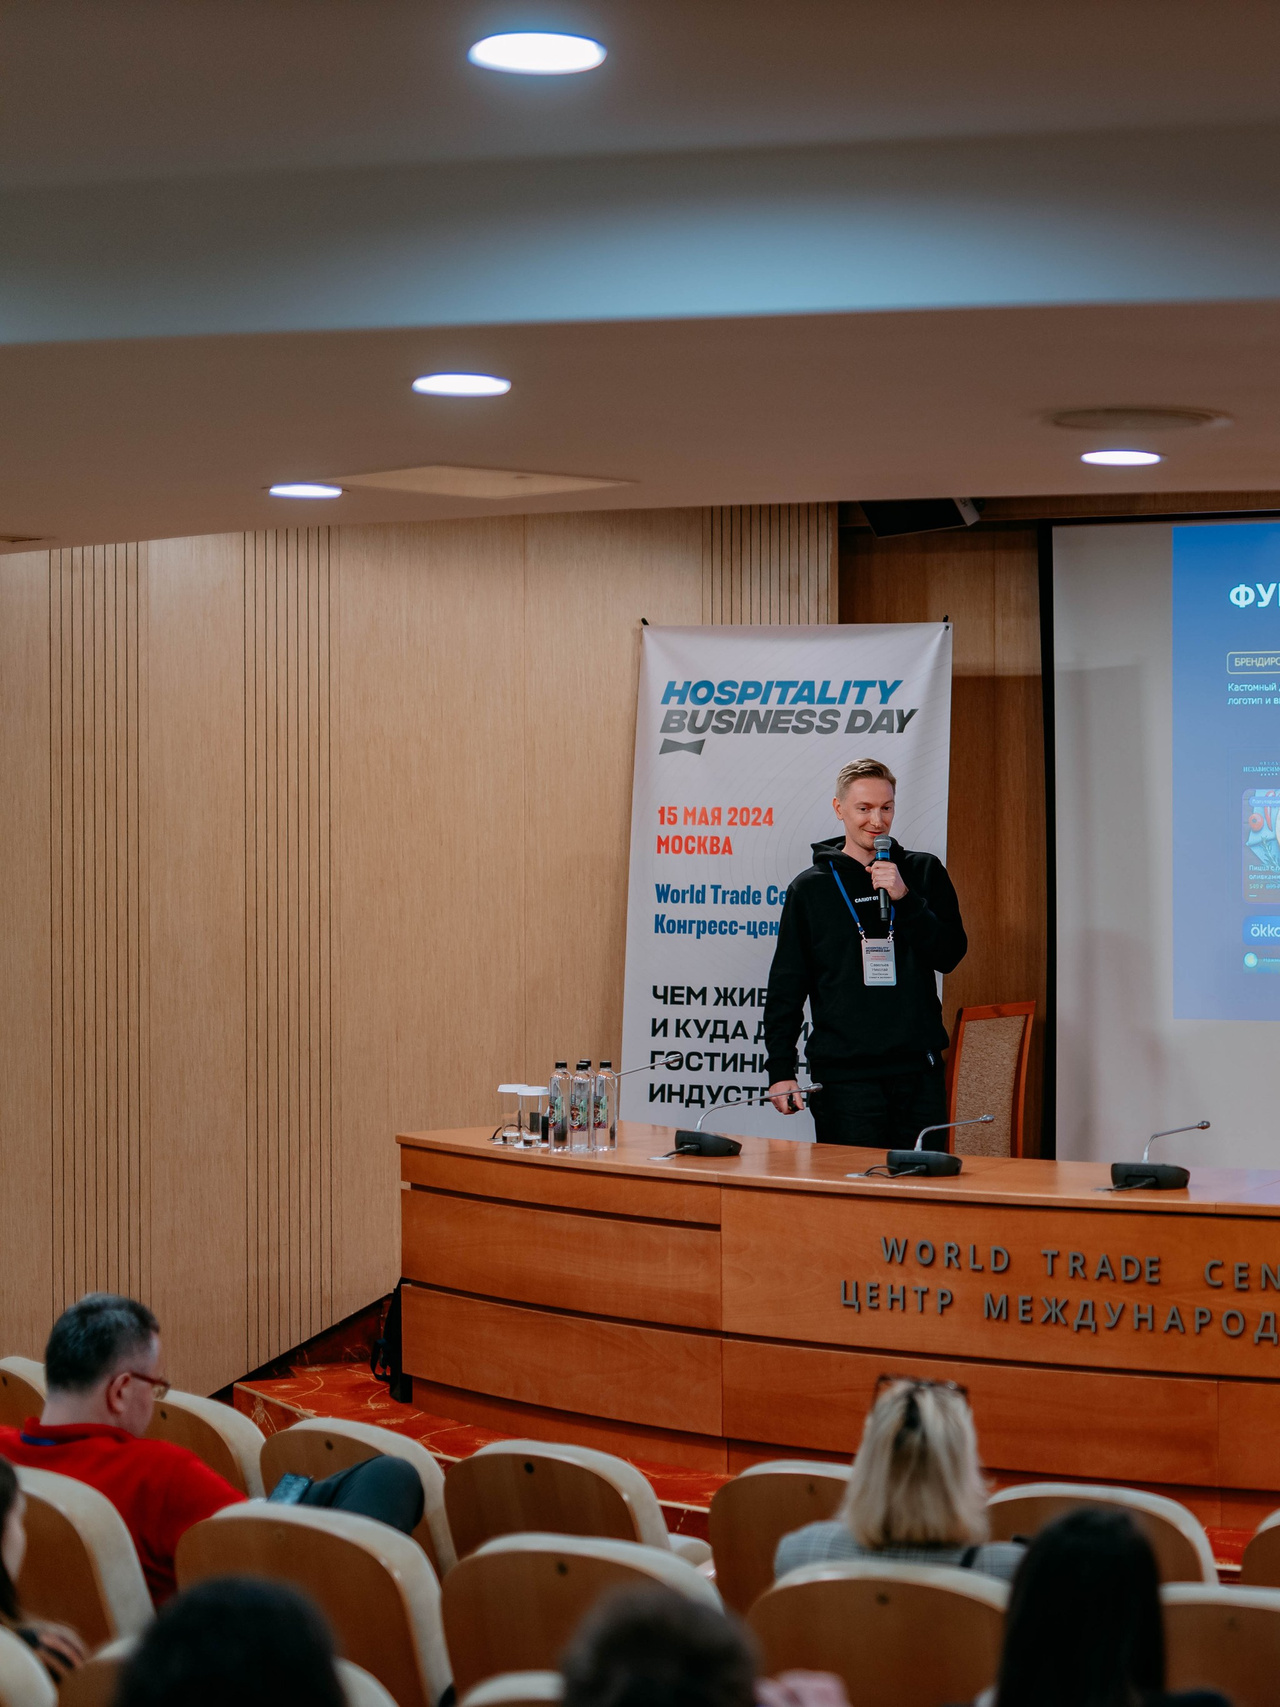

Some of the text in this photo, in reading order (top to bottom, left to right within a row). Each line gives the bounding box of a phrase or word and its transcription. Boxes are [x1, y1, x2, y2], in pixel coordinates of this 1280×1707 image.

[661, 680, 903, 705] HOSPITALITY
[1228, 683, 1276, 692] Кастомный
[1228, 697, 1262, 706] логотип
[659, 708, 919, 734] BUSINESS DAY
[658, 806, 774, 826] 15 МАЯ 2024
[656, 835, 733, 855] МОСКВА
[655, 883, 706, 905] World
[710, 884, 762, 905] Trade
[652, 985, 707, 1006] ЧЕМ
[651, 1017, 668, 1038] И
[674, 1019, 748, 1044] КУДА
[881, 1236, 1010, 1272] WORLD
[1041, 1250, 1161, 1284] TRADE
[840, 1280, 953, 1314] ЦЕНТР
